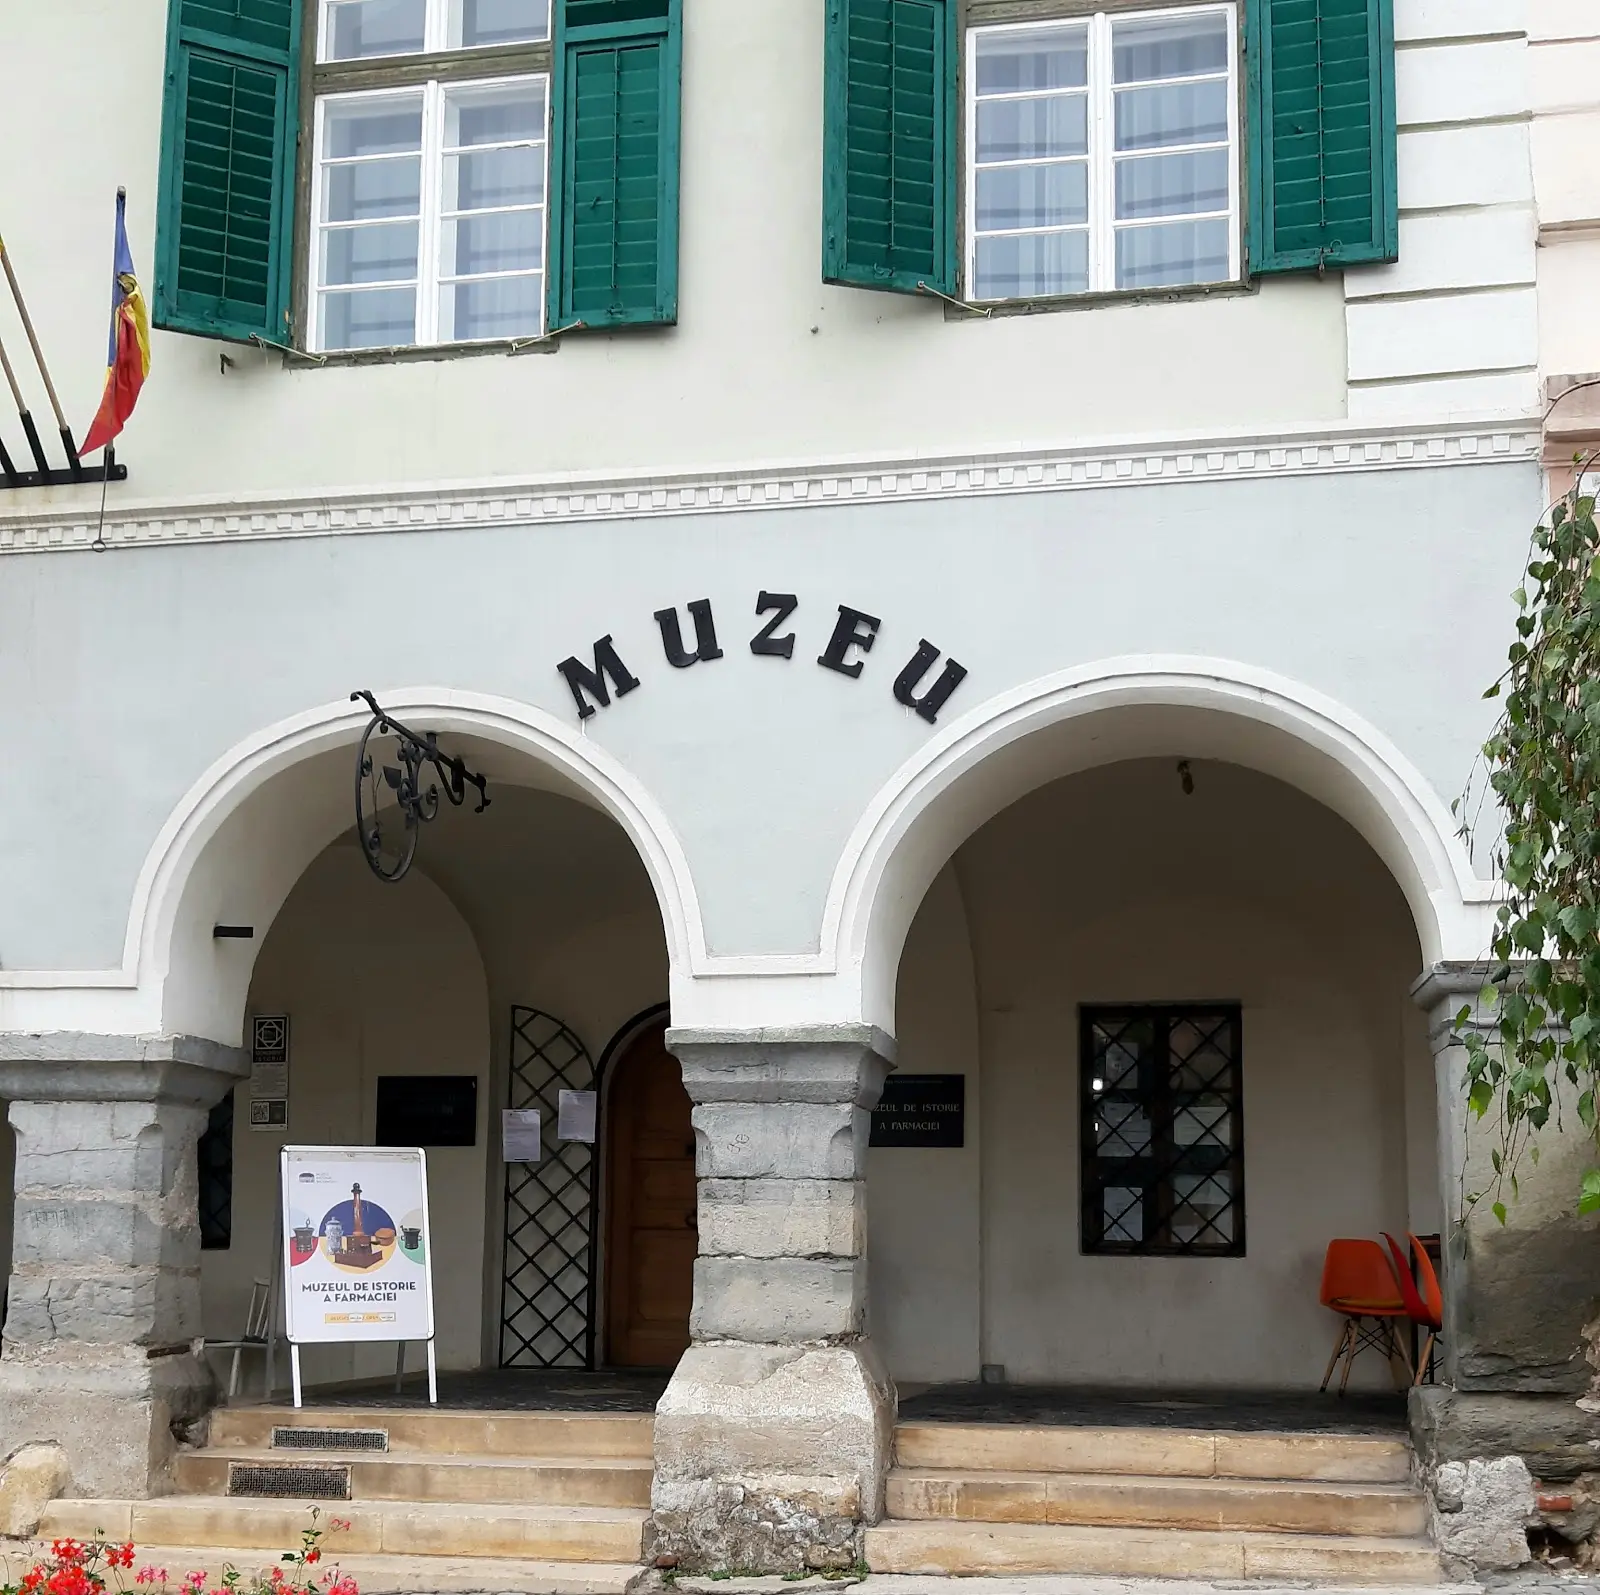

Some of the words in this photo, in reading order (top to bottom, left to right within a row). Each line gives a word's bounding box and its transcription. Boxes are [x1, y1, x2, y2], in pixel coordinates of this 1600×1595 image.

[556, 590, 968, 724] MUZEU
[873, 1103, 898, 1112] ZEUL
[903, 1103, 917, 1112] DE
[922, 1103, 960, 1112] ISTORIE
[879, 1121, 886, 1130] A
[891, 1121, 940, 1130] FARMACIEI
[301, 1282, 350, 1292] MUZEUL
[353, 1282, 369, 1291] DE
[372, 1281, 416, 1291] ISTORIE
[323, 1293, 332, 1302] A
[335, 1292, 397, 1302] FARMACIEI
